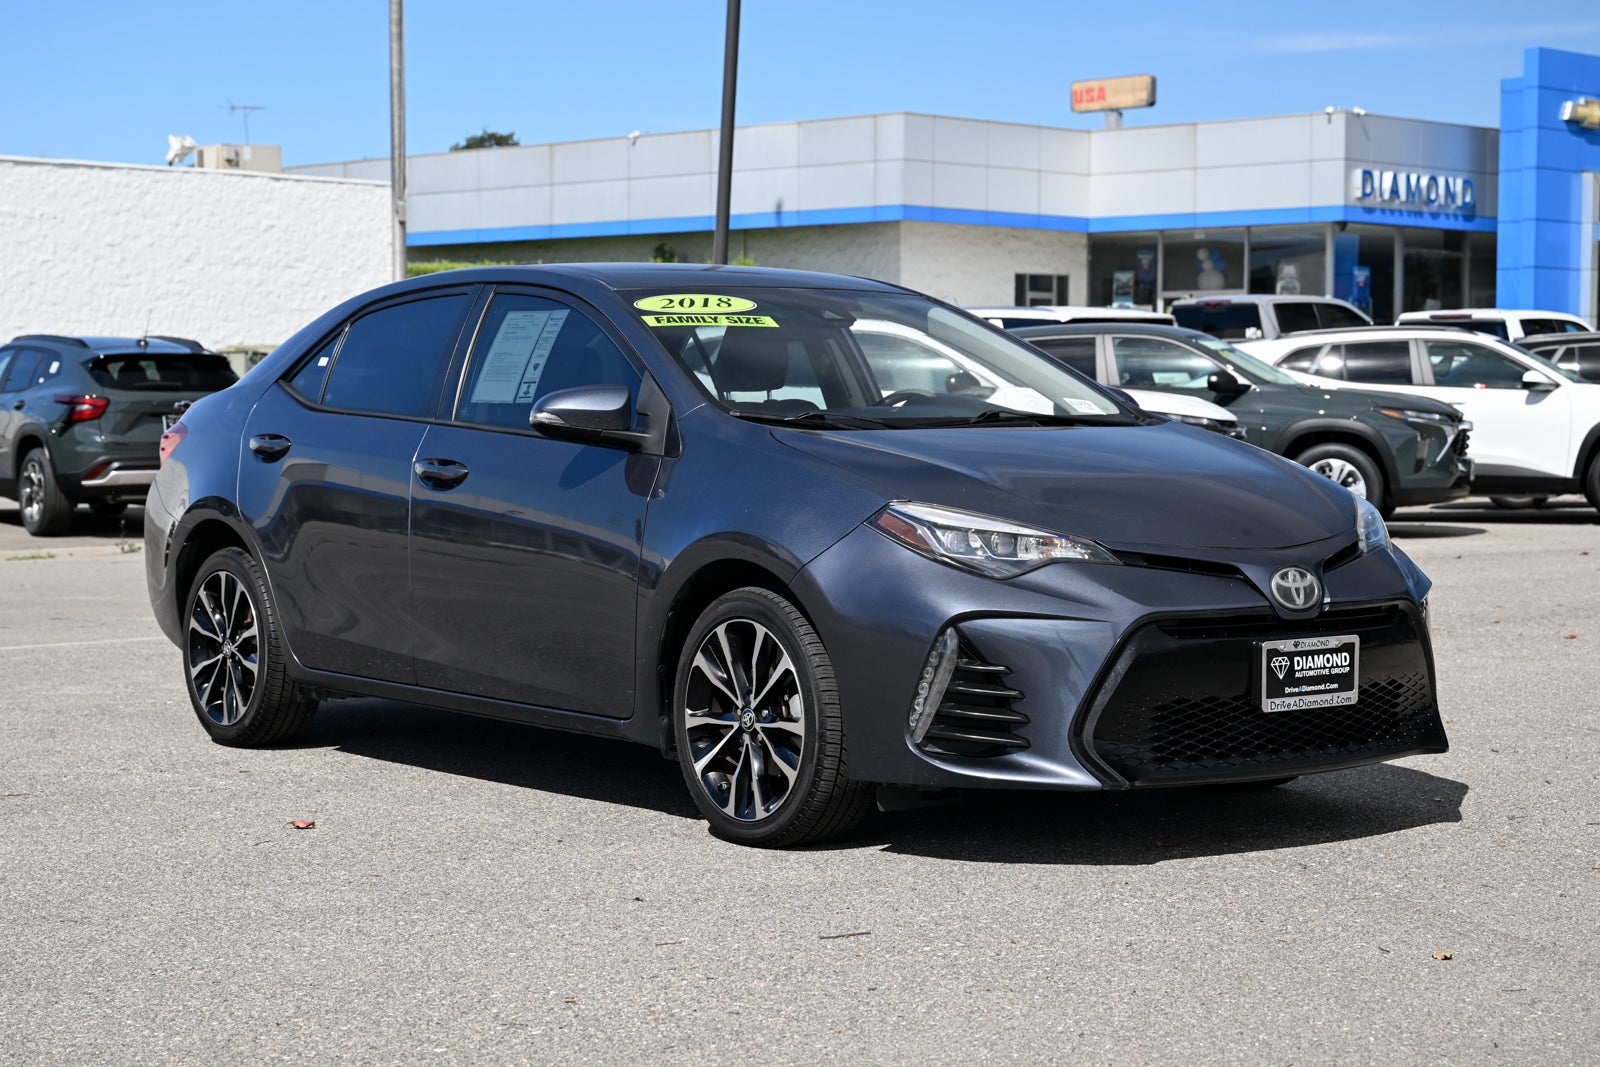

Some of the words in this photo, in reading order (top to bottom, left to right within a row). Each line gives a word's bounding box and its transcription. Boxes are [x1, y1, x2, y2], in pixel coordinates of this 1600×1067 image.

[1073, 86, 1106, 105] USA
[1360, 169, 1474, 207] DIAMOND
[660, 297, 732, 309] 2018
[654, 316, 719, 324] FAMILY
[725, 316, 765, 325] SIZE
[1300, 639, 1330, 649] DIAMOND
[1294, 652, 1350, 671] DIAMOND
[1295, 668, 1330, 678] AUTOMOTIVE
[1330, 666, 1350, 675] GROUP
[1284, 682, 1339, 694] DriveADiamond.Com
